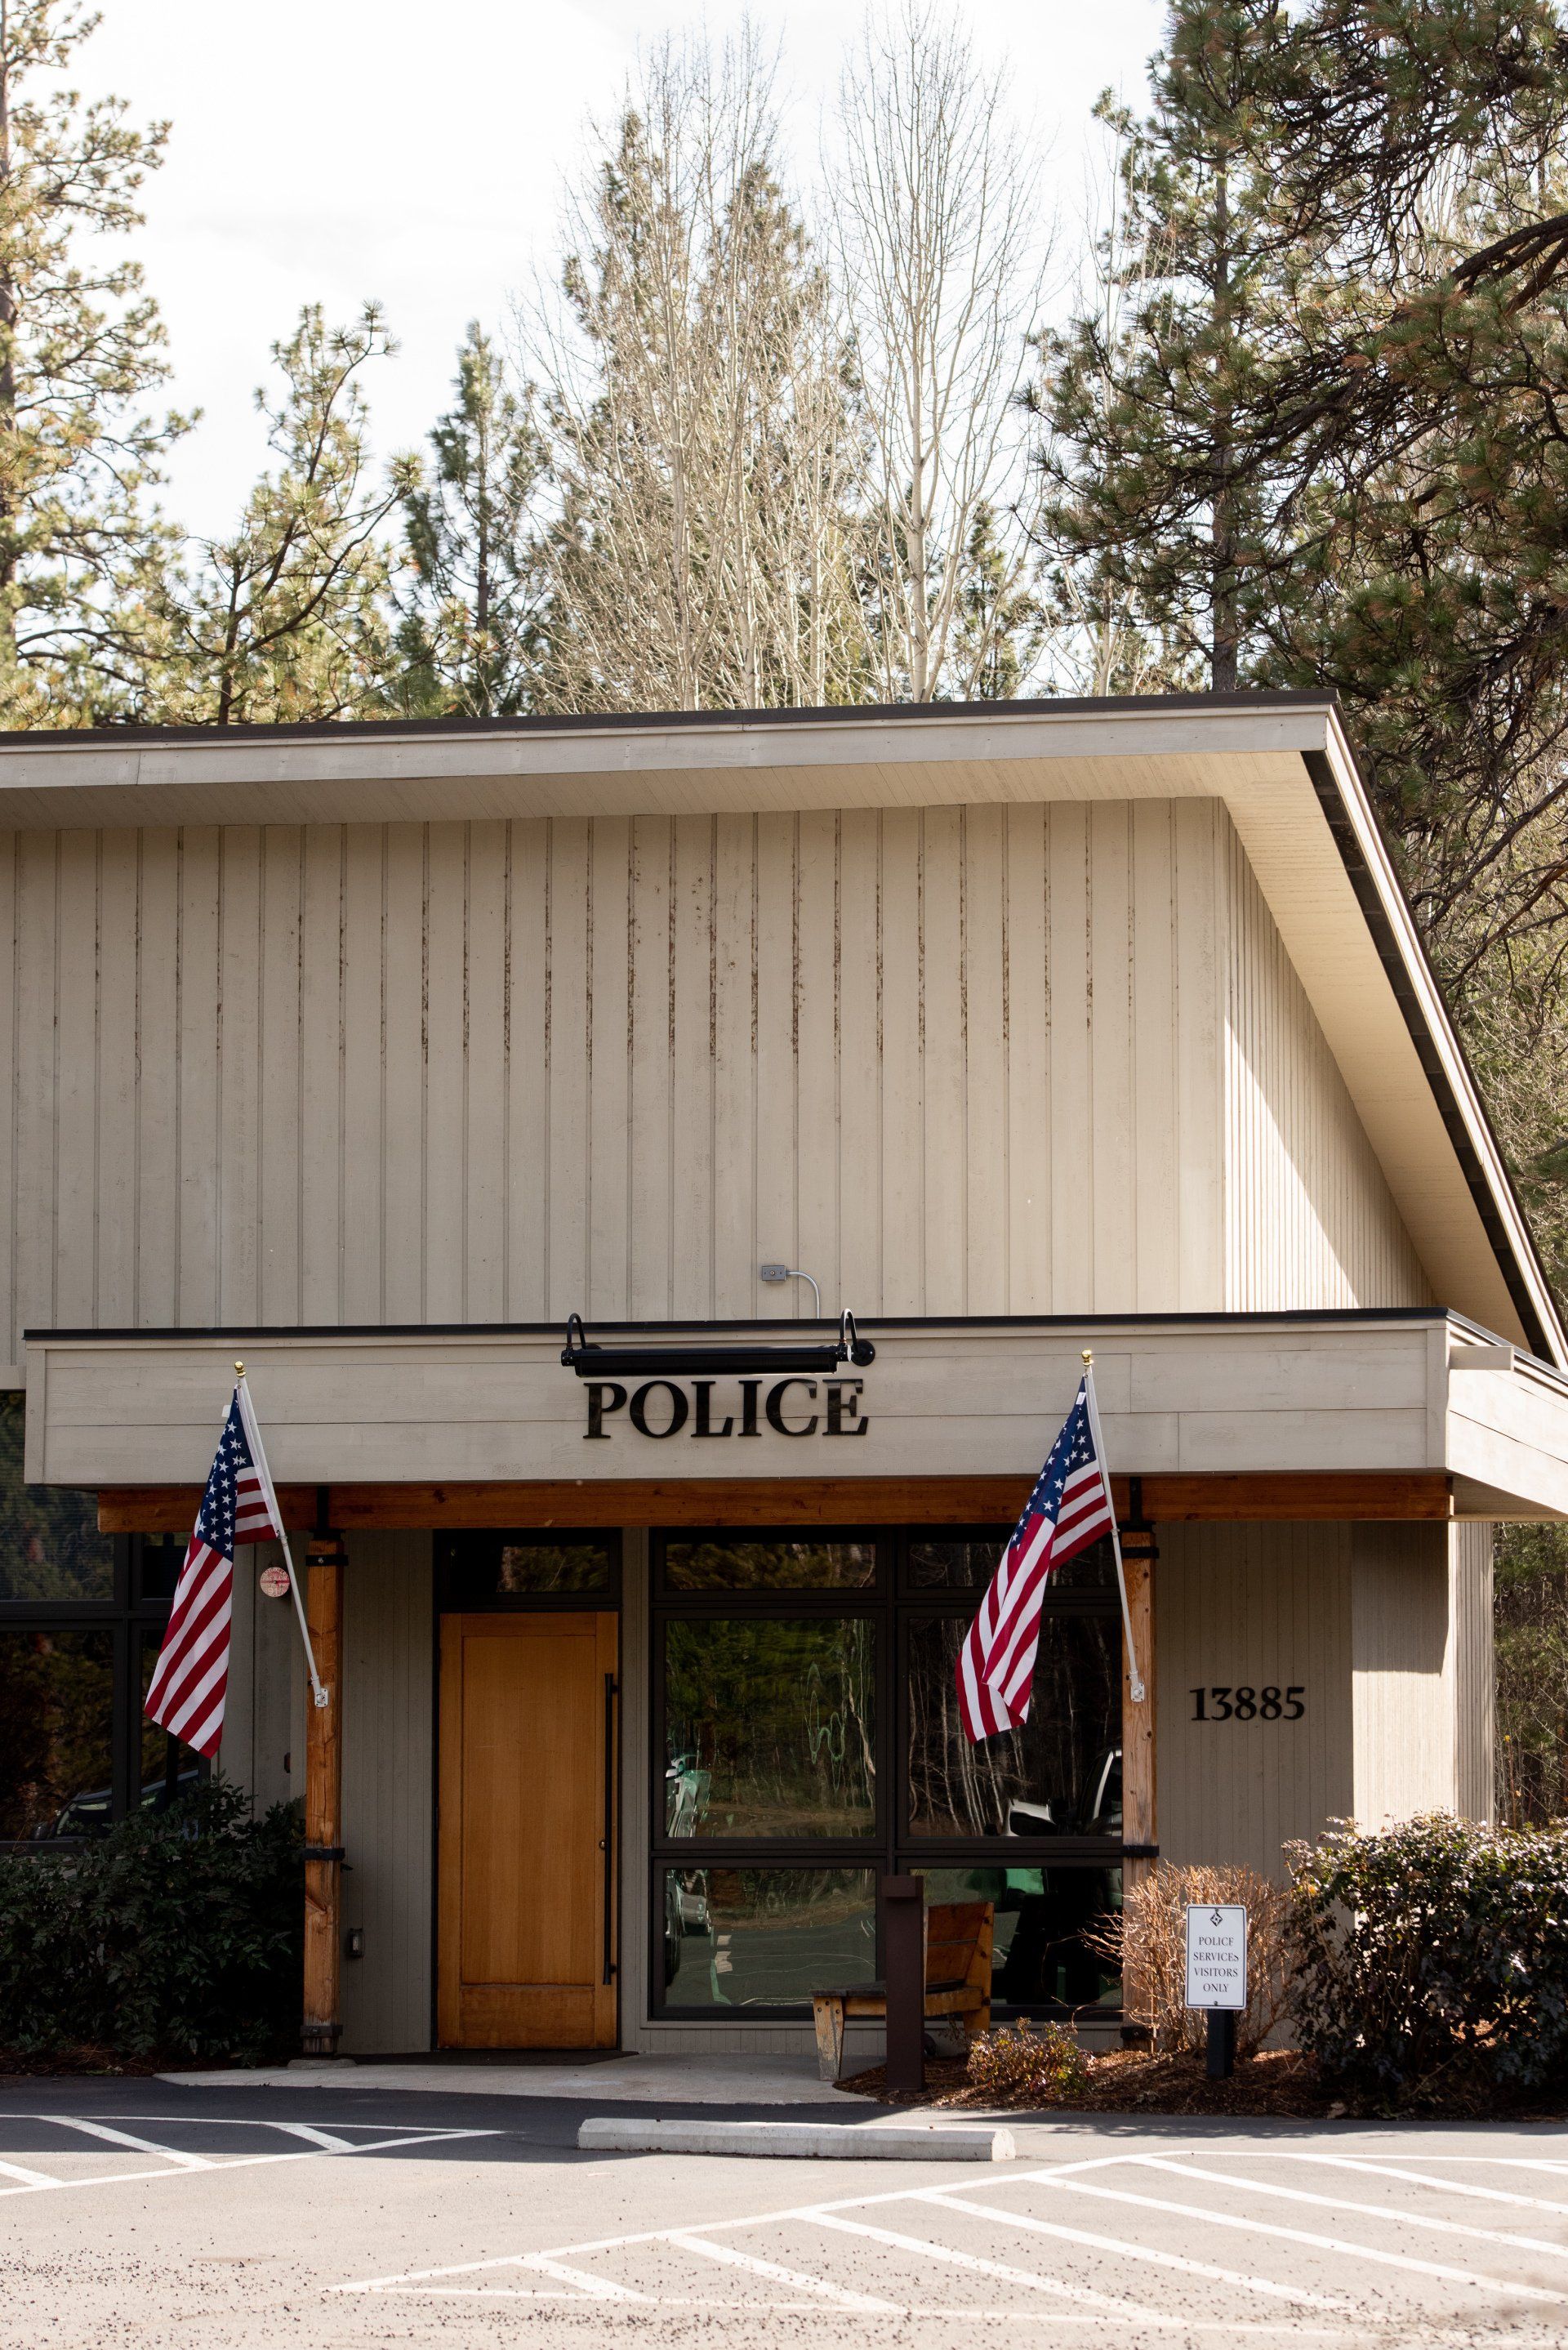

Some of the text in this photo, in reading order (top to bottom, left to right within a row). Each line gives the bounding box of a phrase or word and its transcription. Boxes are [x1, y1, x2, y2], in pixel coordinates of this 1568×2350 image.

[583, 1378, 869, 1438] POLICE
[1189, 1686, 1305, 1721] 13885
[1199, 1937, 1234, 1946] POLICE
[1193, 1952, 1239, 1962] SERVICES
[1194, 1968, 1238, 1978] VISITORS
[1203, 1983, 1230, 1992] ONLY
